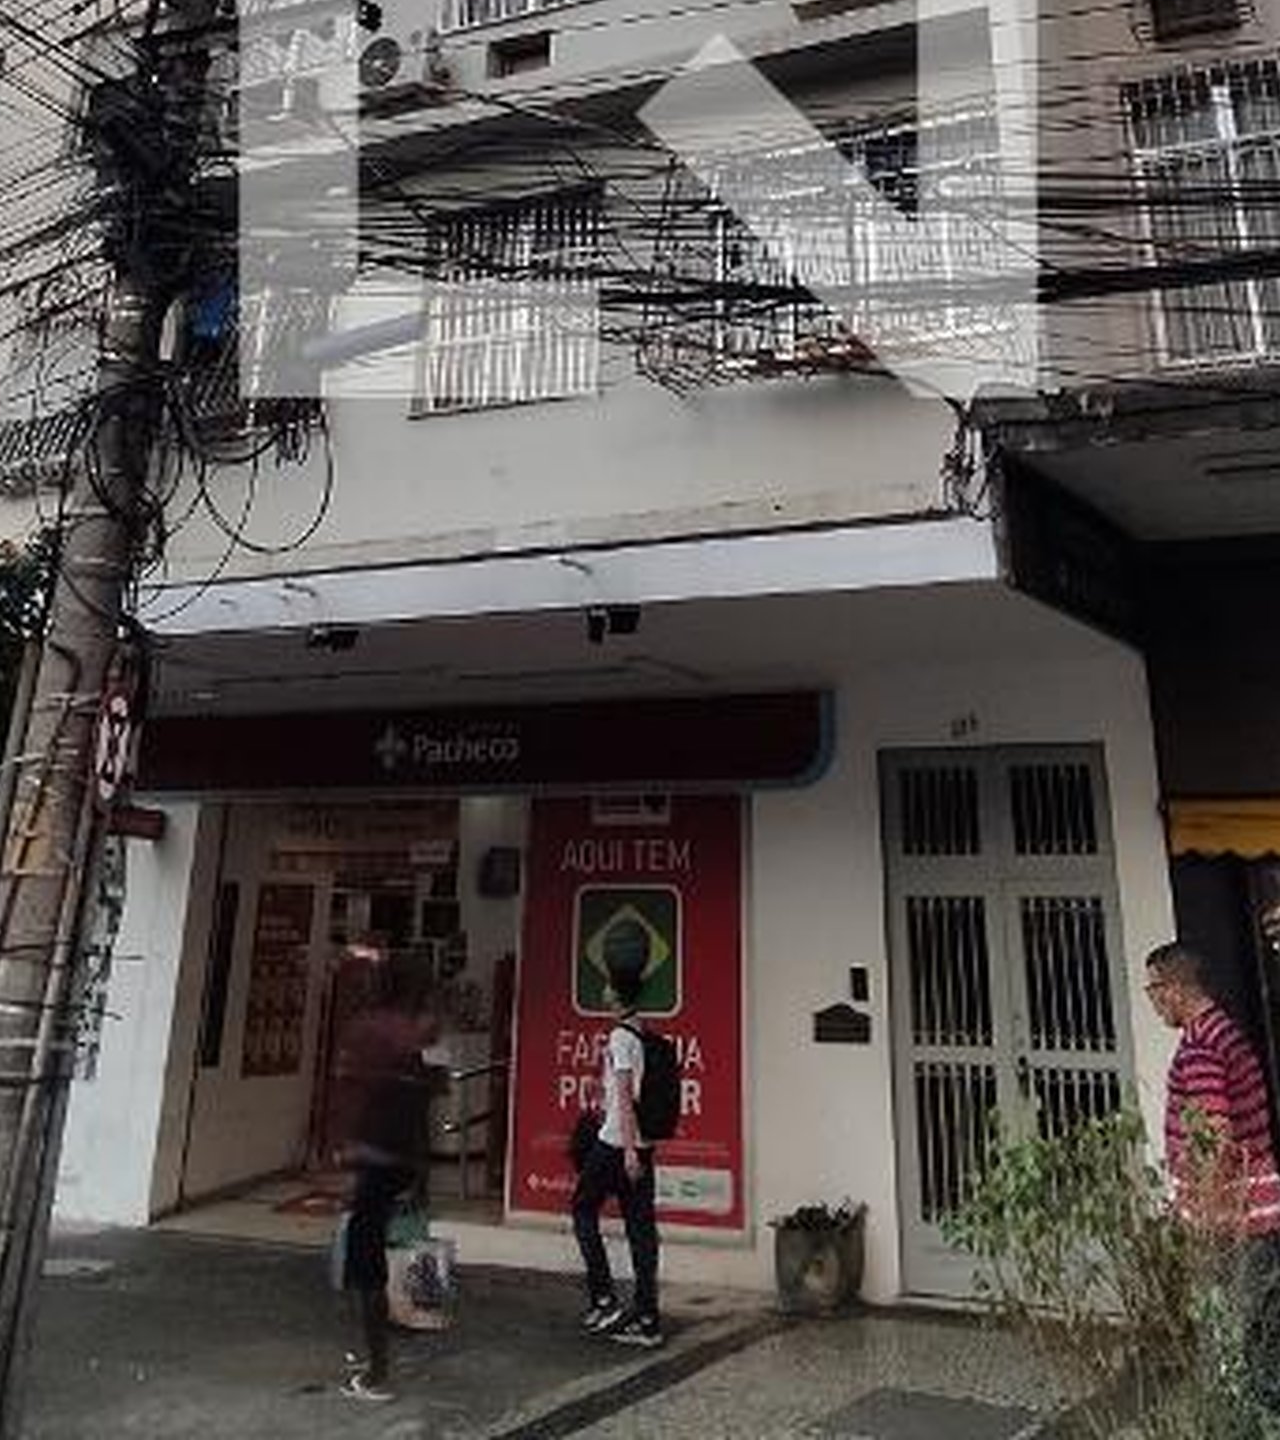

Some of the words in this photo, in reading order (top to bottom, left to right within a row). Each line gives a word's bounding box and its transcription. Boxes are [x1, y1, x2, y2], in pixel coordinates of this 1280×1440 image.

[412, 731, 520, 763] Pacheco
[560, 839, 624, 873] AQUI
[634, 838, 692, 871] TEM
